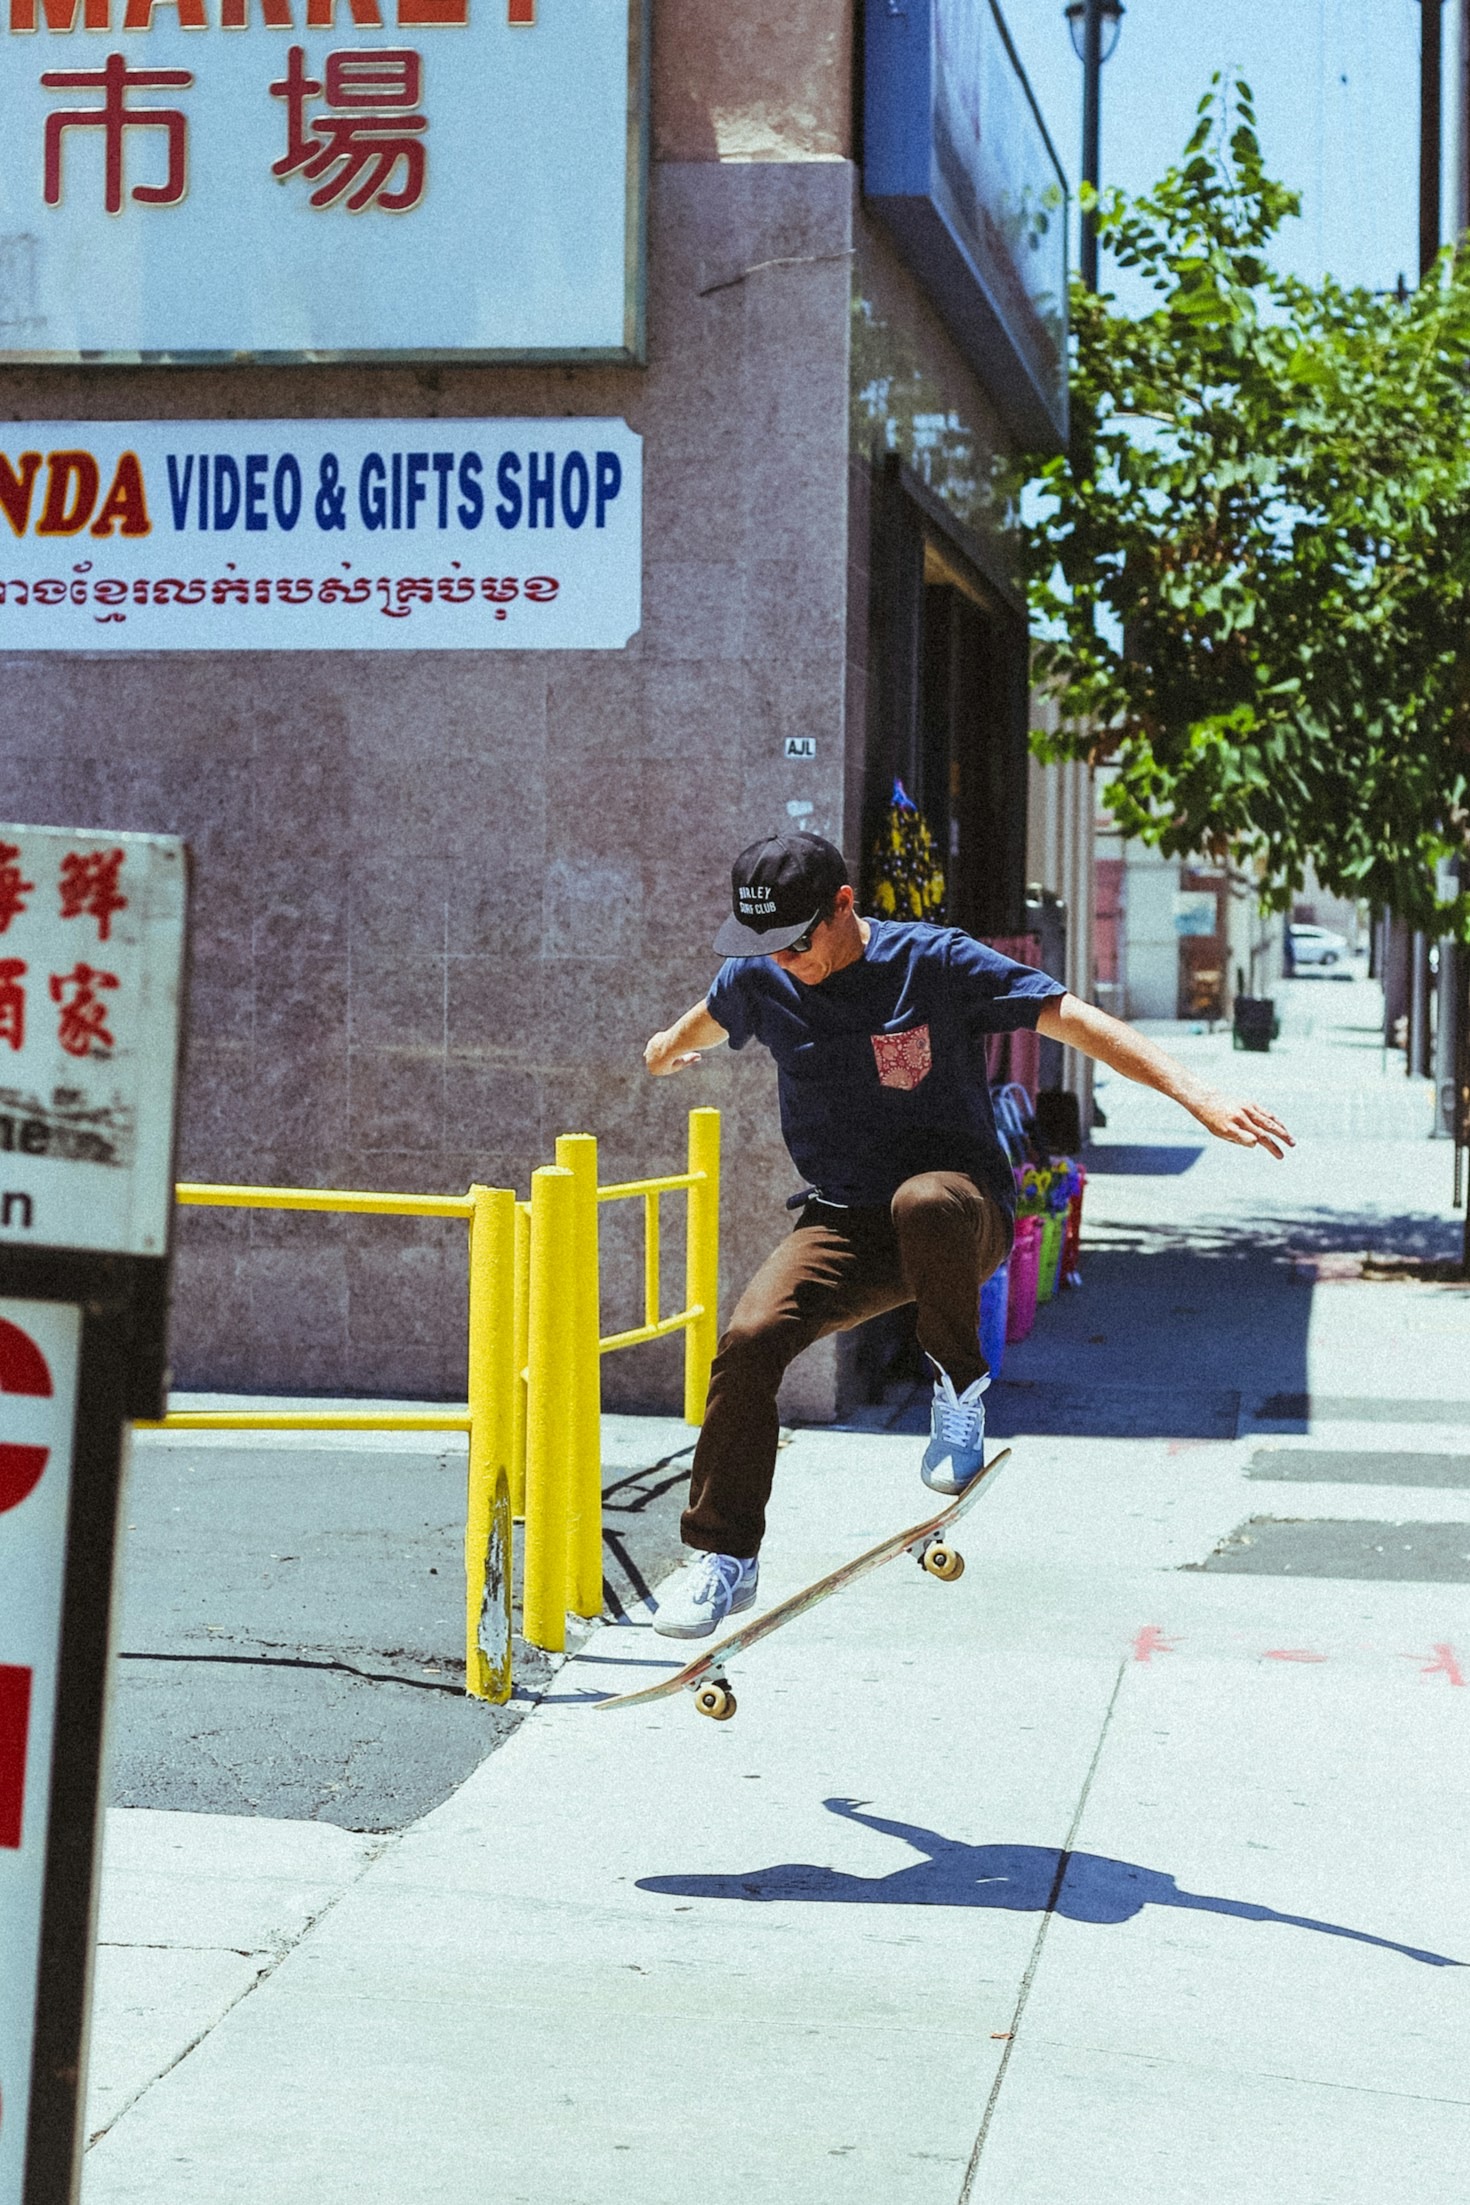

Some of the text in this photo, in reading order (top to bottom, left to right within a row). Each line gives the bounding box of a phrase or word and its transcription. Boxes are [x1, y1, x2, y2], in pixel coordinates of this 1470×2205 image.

[40, 45, 428, 216] 市場
[165, 452, 302, 531] VIDEO
[315, 452, 346, 531] &
[359, 450, 484, 531] GIFTS
[496, 450, 622, 530] SHOP
[788, 740, 814, 755] AJL
[755, 901, 777, 914] CLUB
